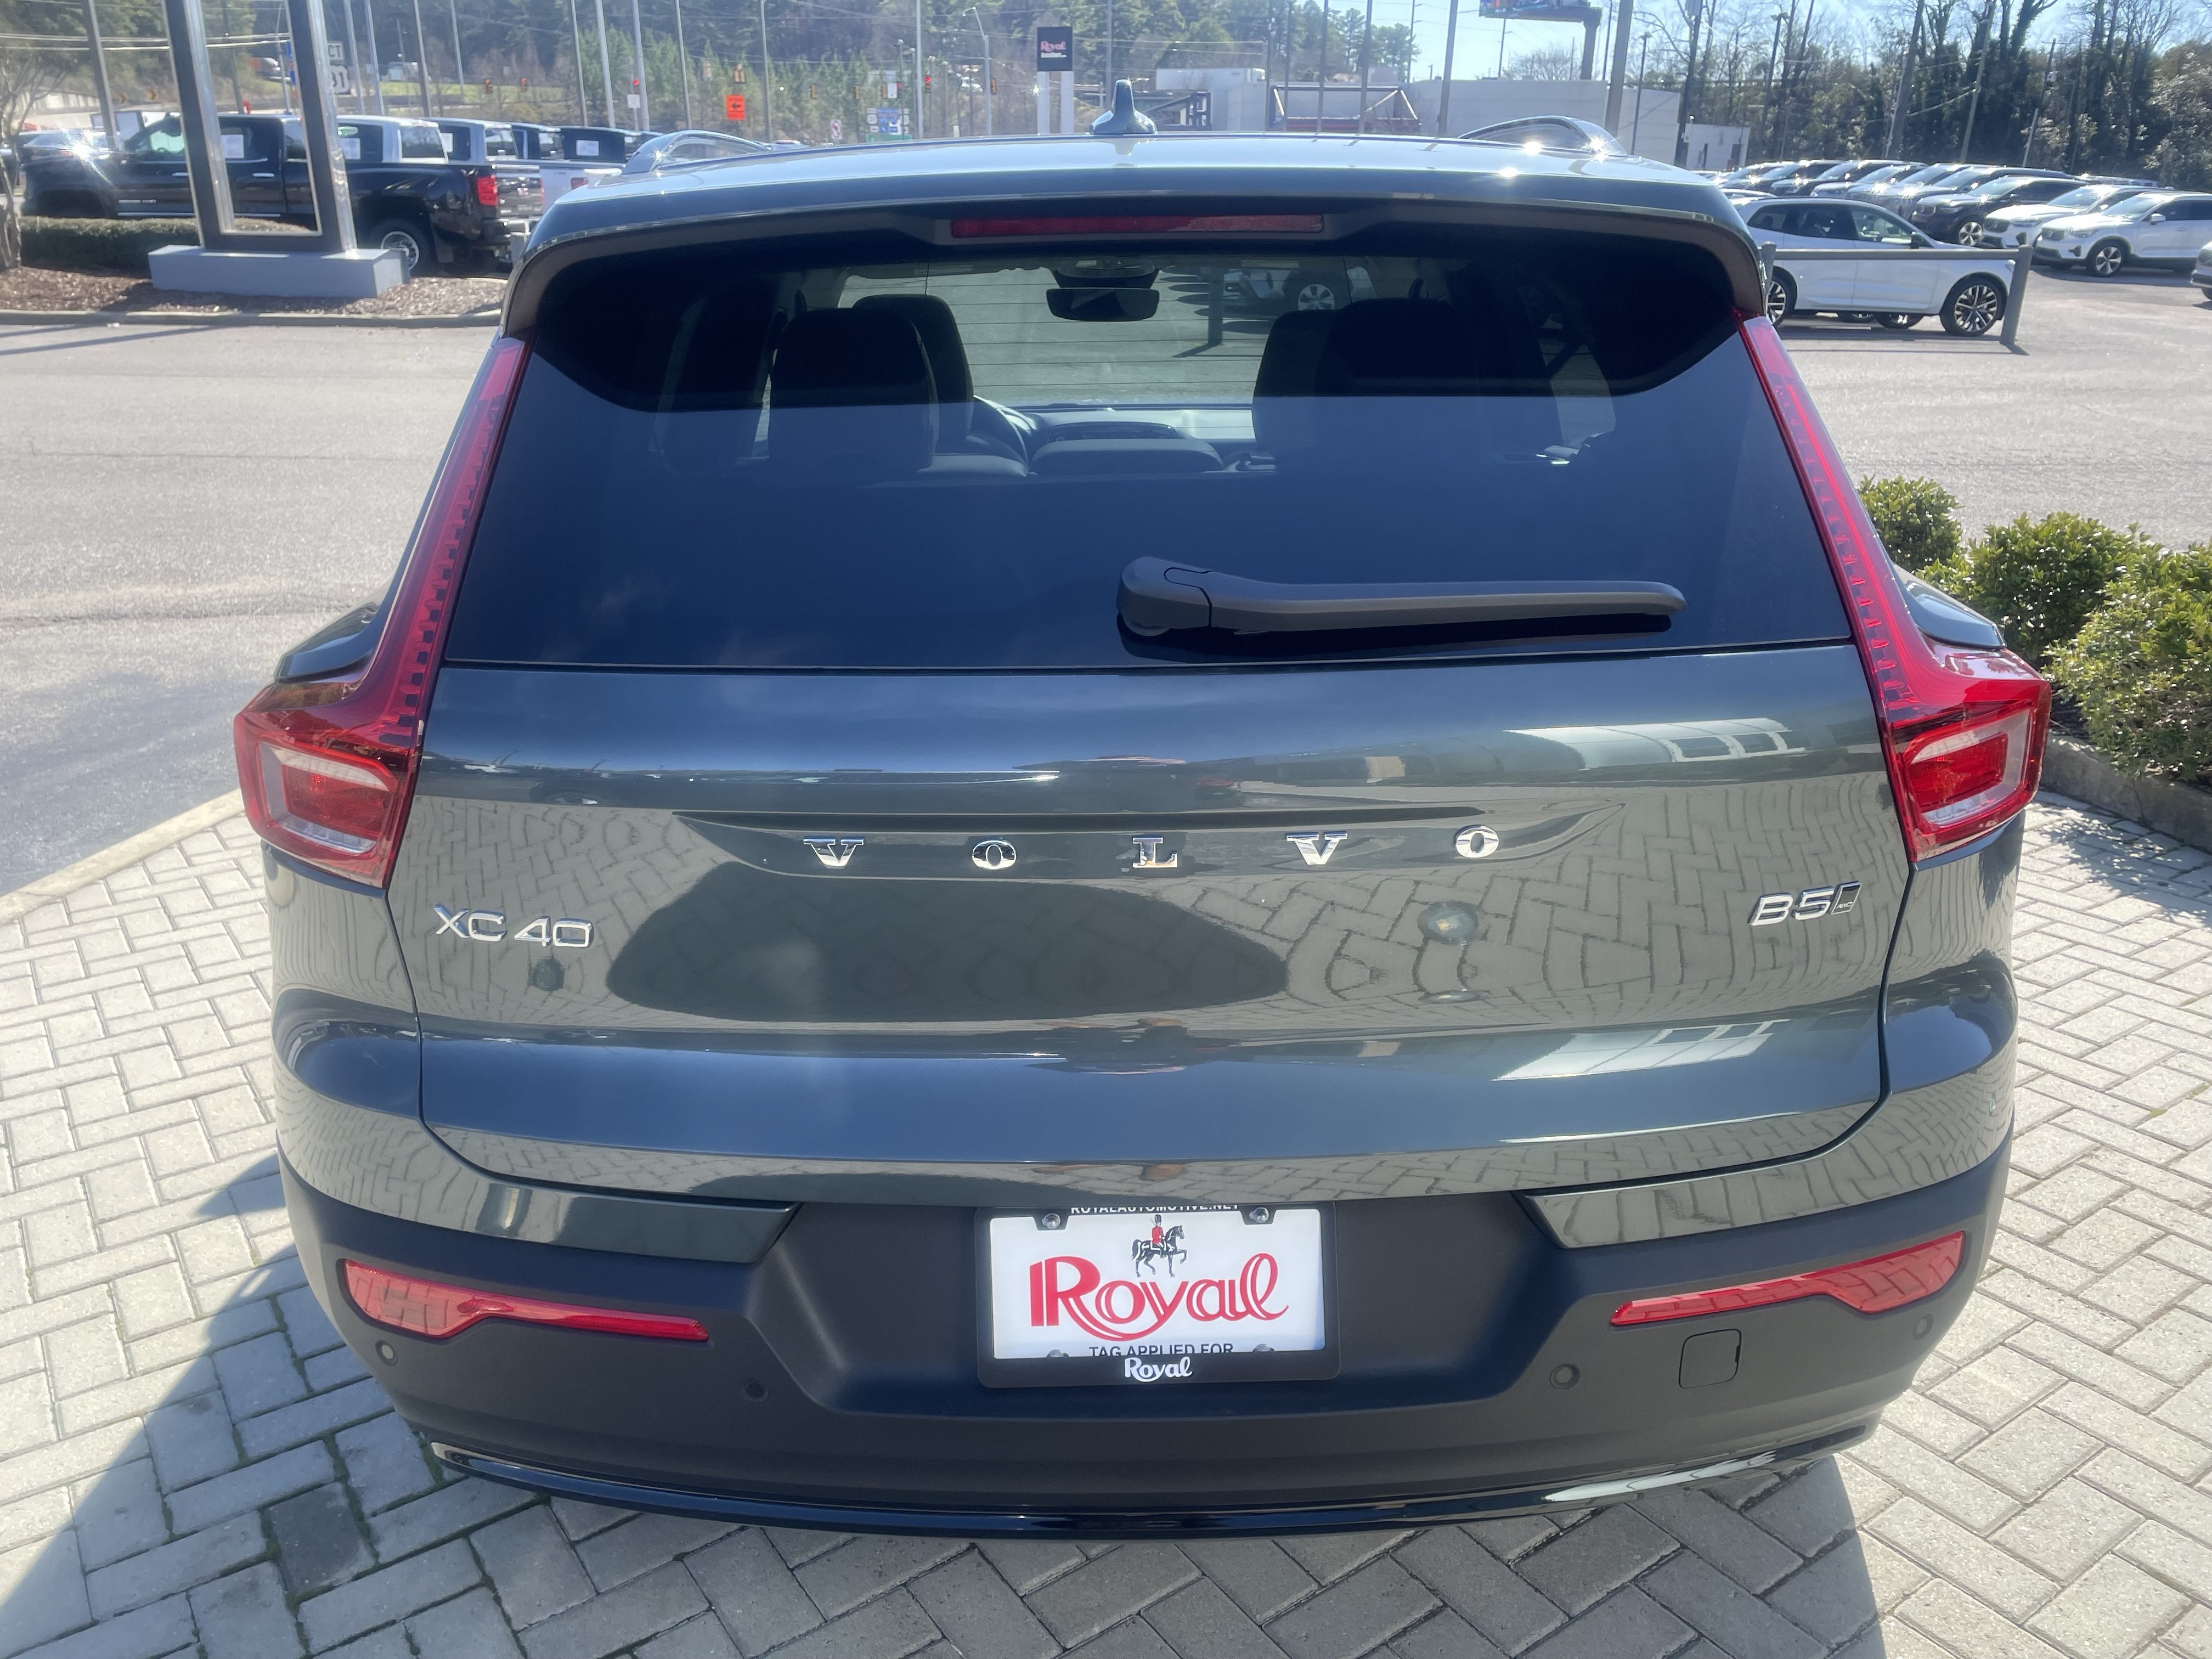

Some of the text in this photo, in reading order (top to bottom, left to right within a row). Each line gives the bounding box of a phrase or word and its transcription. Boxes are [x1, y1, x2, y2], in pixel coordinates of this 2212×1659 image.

[328, 45, 341, 58] CT
[1040, 41, 1066, 52] Royal
[803, 824, 1499, 872] VOLVO
[1749, 887, 1835, 926] B5
[1029, 1252, 1289, 1341] Royal
[1089, 1343, 1234, 1357] TAG APPLIED FOR
[1124, 1356, 1193, 1383] Royal
